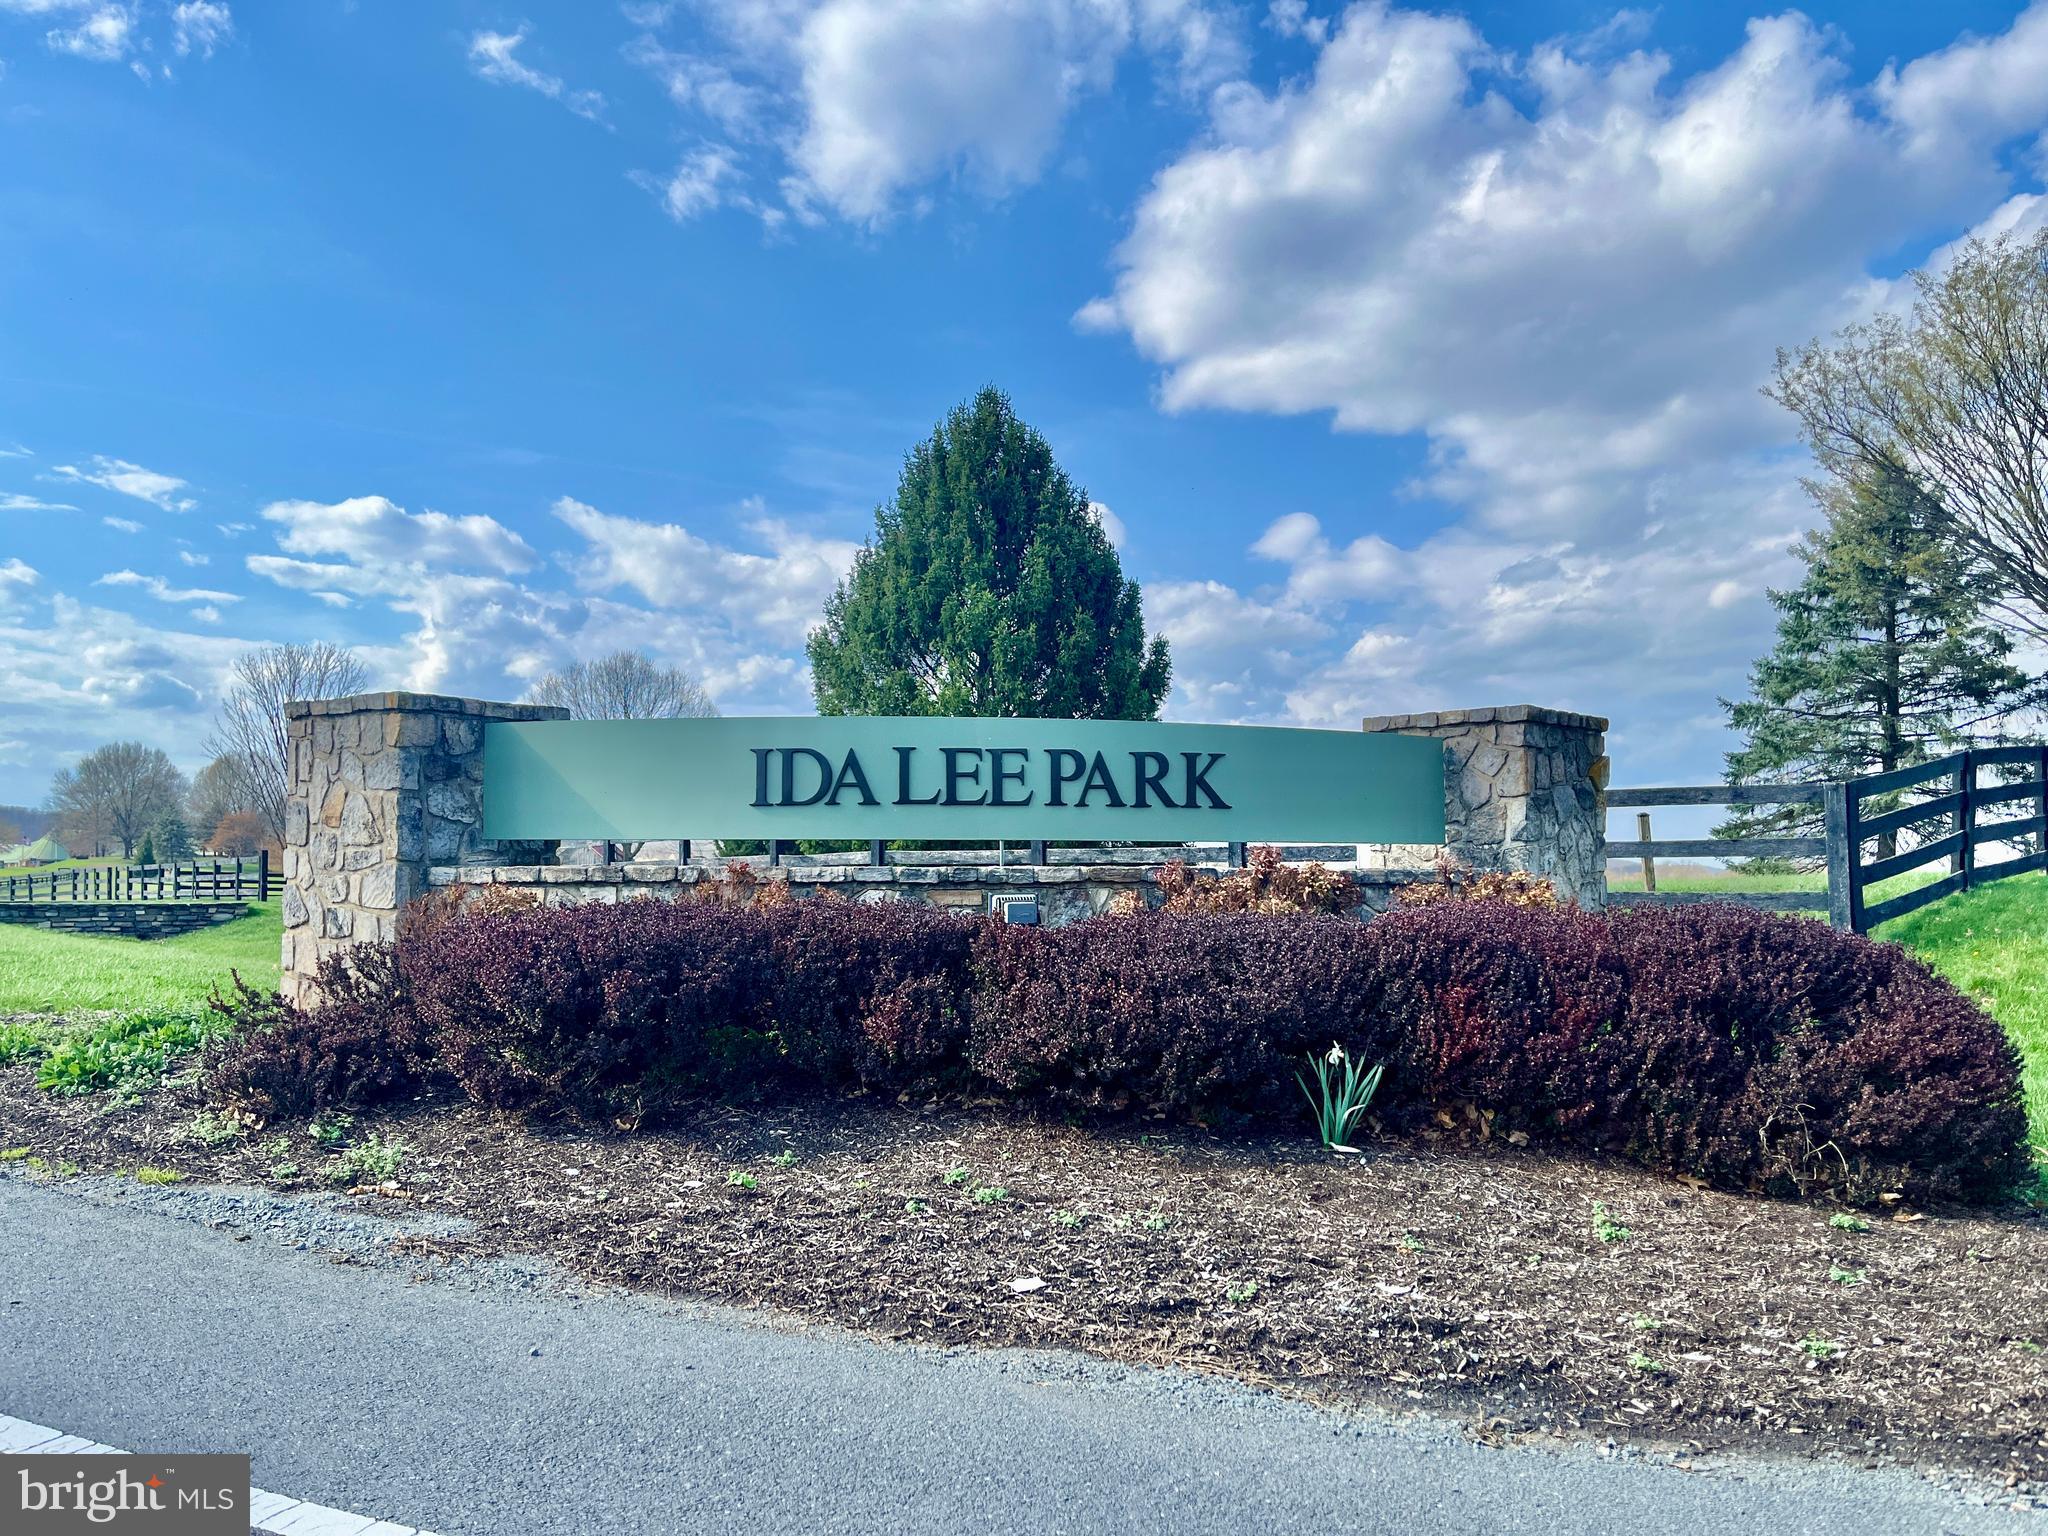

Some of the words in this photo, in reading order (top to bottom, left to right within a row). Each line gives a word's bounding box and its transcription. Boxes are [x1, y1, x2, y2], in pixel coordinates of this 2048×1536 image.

[749, 747, 881, 807] IDA
[891, 746, 1034, 807] LEE
[1043, 748, 1233, 810] PARK
